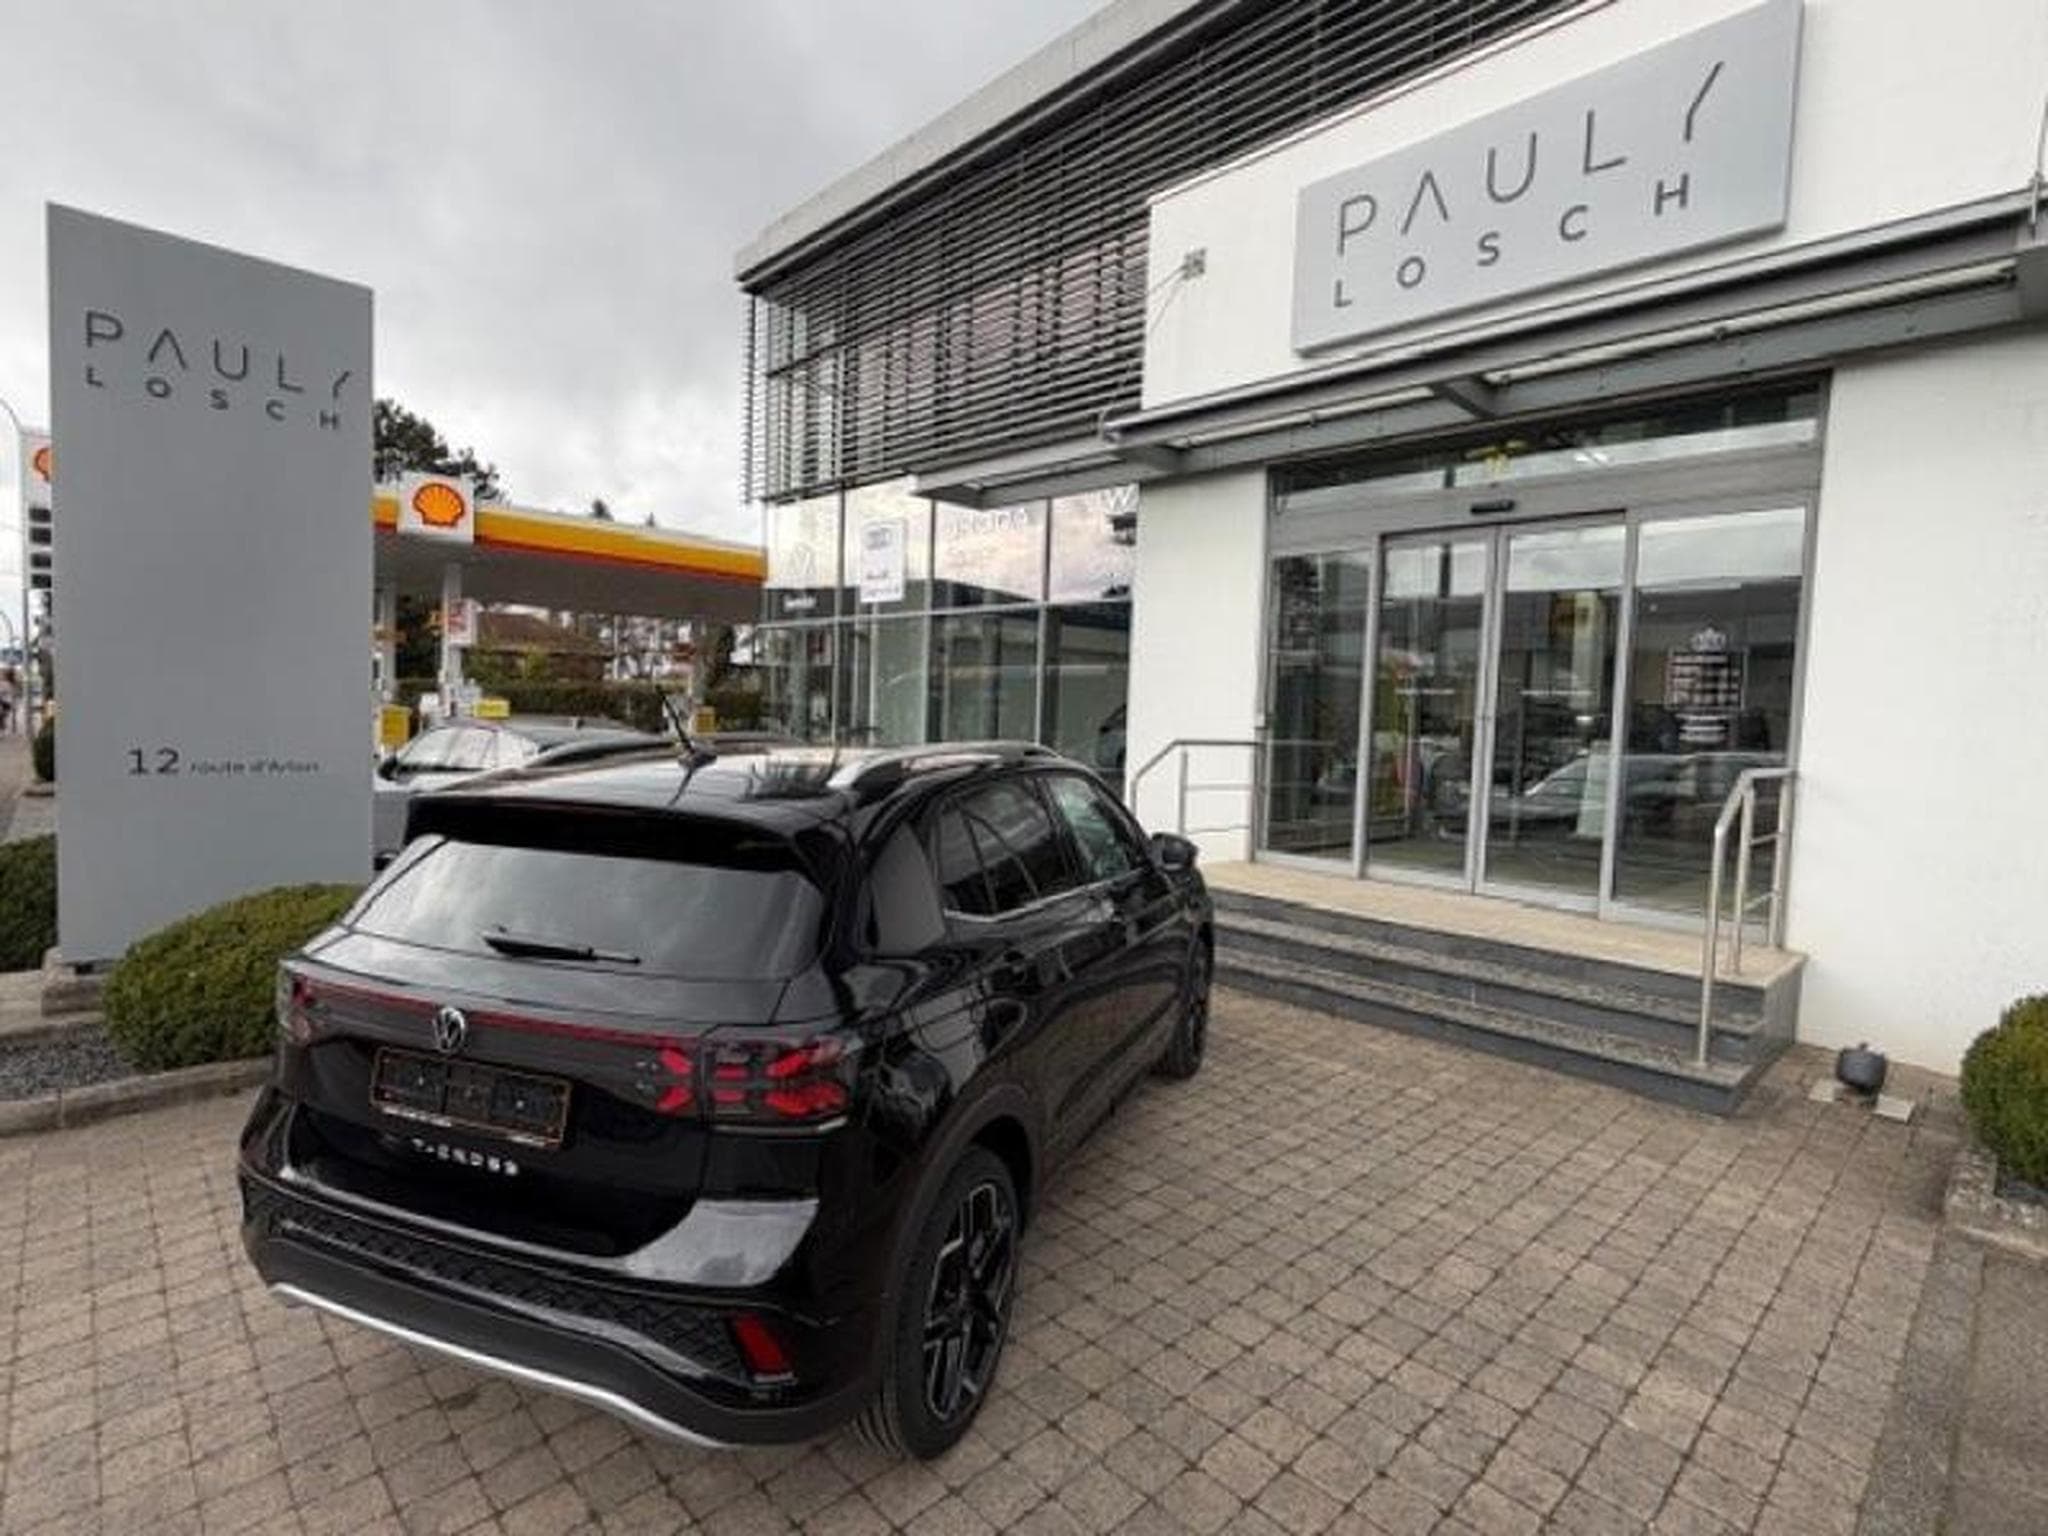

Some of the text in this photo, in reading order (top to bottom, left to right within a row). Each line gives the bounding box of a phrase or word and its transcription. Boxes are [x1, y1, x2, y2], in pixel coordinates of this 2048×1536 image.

[1337, 61, 1724, 256] PAULY
[1334, 173, 1690, 308] LOSCH
[85, 309, 352, 399] PAULY
[85, 365, 339, 430] LOSCH
[128, 747, 179, 775] 12
